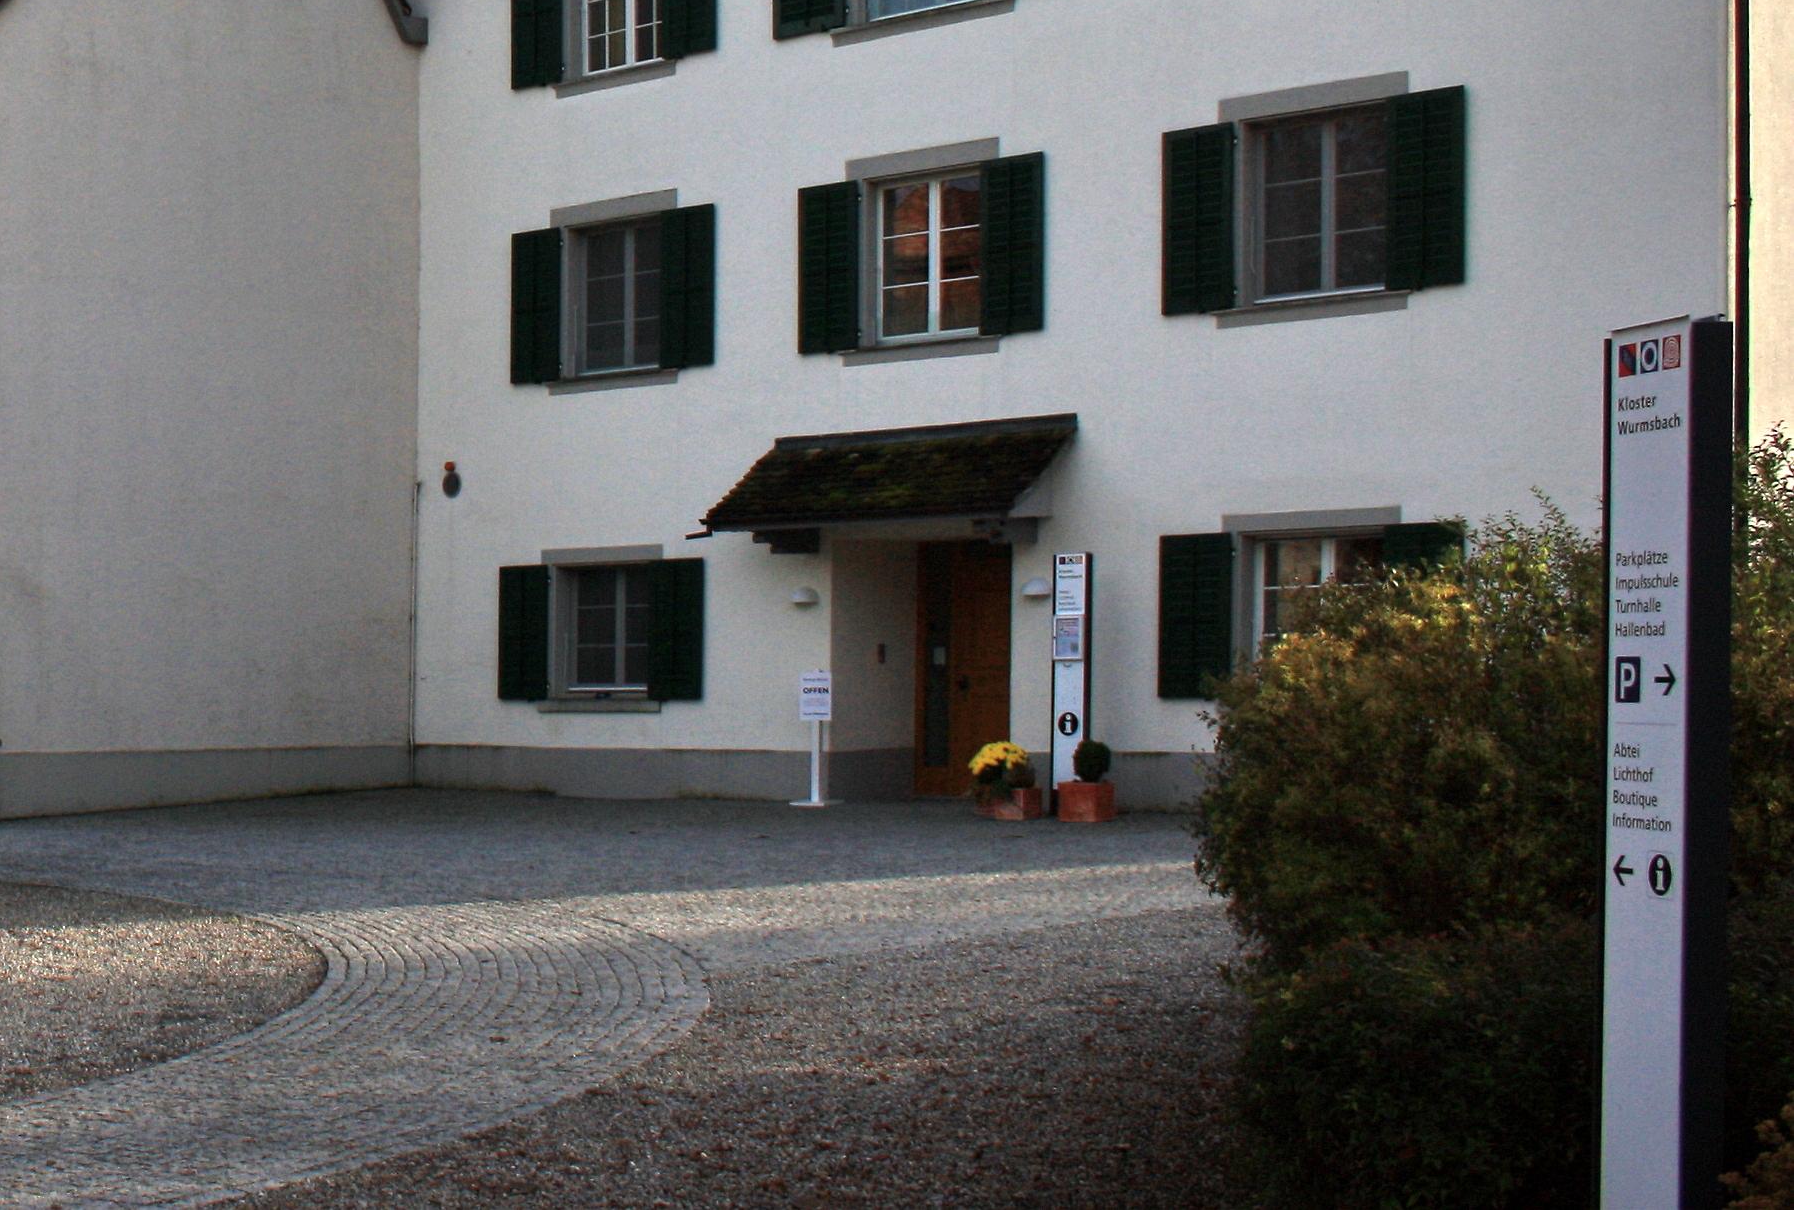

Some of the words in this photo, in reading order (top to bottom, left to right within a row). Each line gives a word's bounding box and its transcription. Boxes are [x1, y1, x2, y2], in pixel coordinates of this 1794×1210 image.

[1618, 395, 1656, 411] Kloster
[1617, 414, 1680, 435] Wurmsbach
[1615, 551, 1668, 568] Parkplätze
[1615, 573, 1679, 592] Impulsschule
[1615, 600, 1661, 614] Turnhalle
[1615, 621, 1666, 637] Hallenbad
[1620, 662, 1636, 700] P
[1613, 743, 1640, 758] Abtei
[1613, 767, 1654, 783] Lichthof
[1612, 790, 1658, 809] Boutique
[1612, 813, 1672, 832] Information
